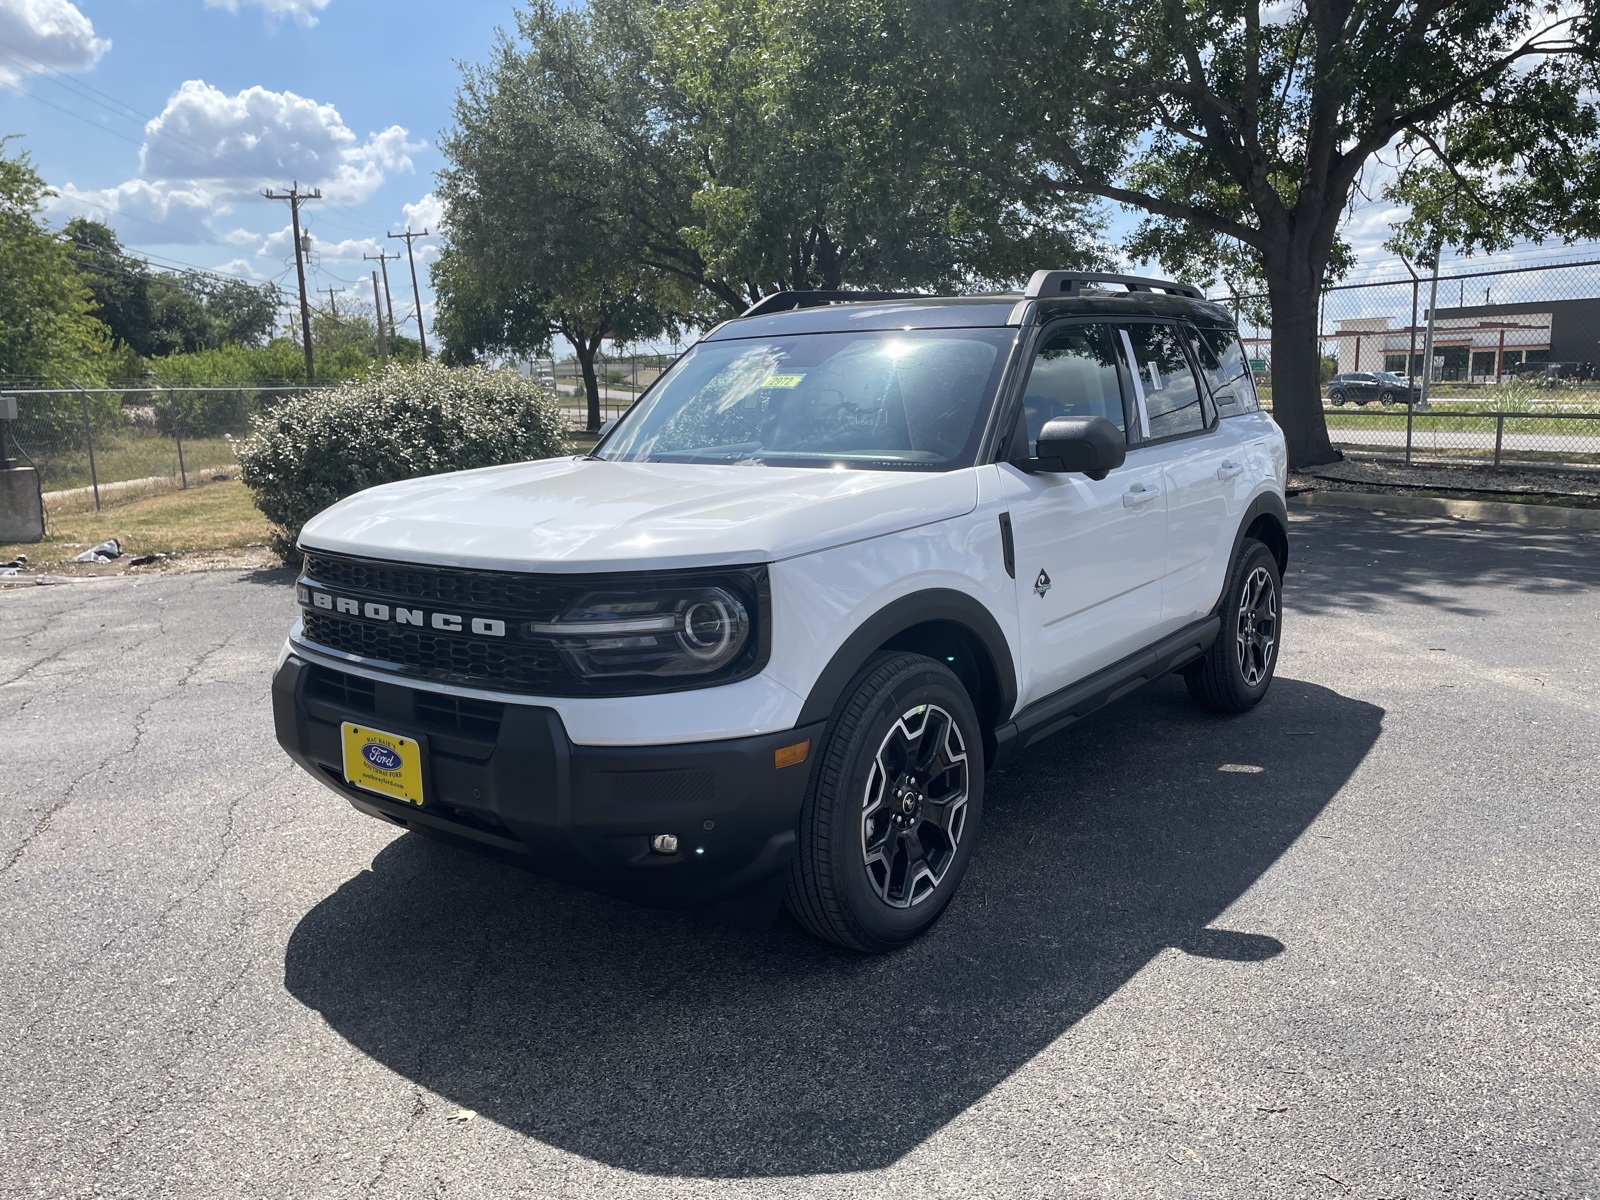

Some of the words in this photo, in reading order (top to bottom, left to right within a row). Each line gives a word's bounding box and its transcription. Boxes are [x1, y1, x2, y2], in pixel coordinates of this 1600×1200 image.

[768, 376, 795, 386] 2972
[313, 592, 506, 637] BRONCO
[369, 746, 395, 767] Ford
[362, 772, 405, 789] southwayford.com
